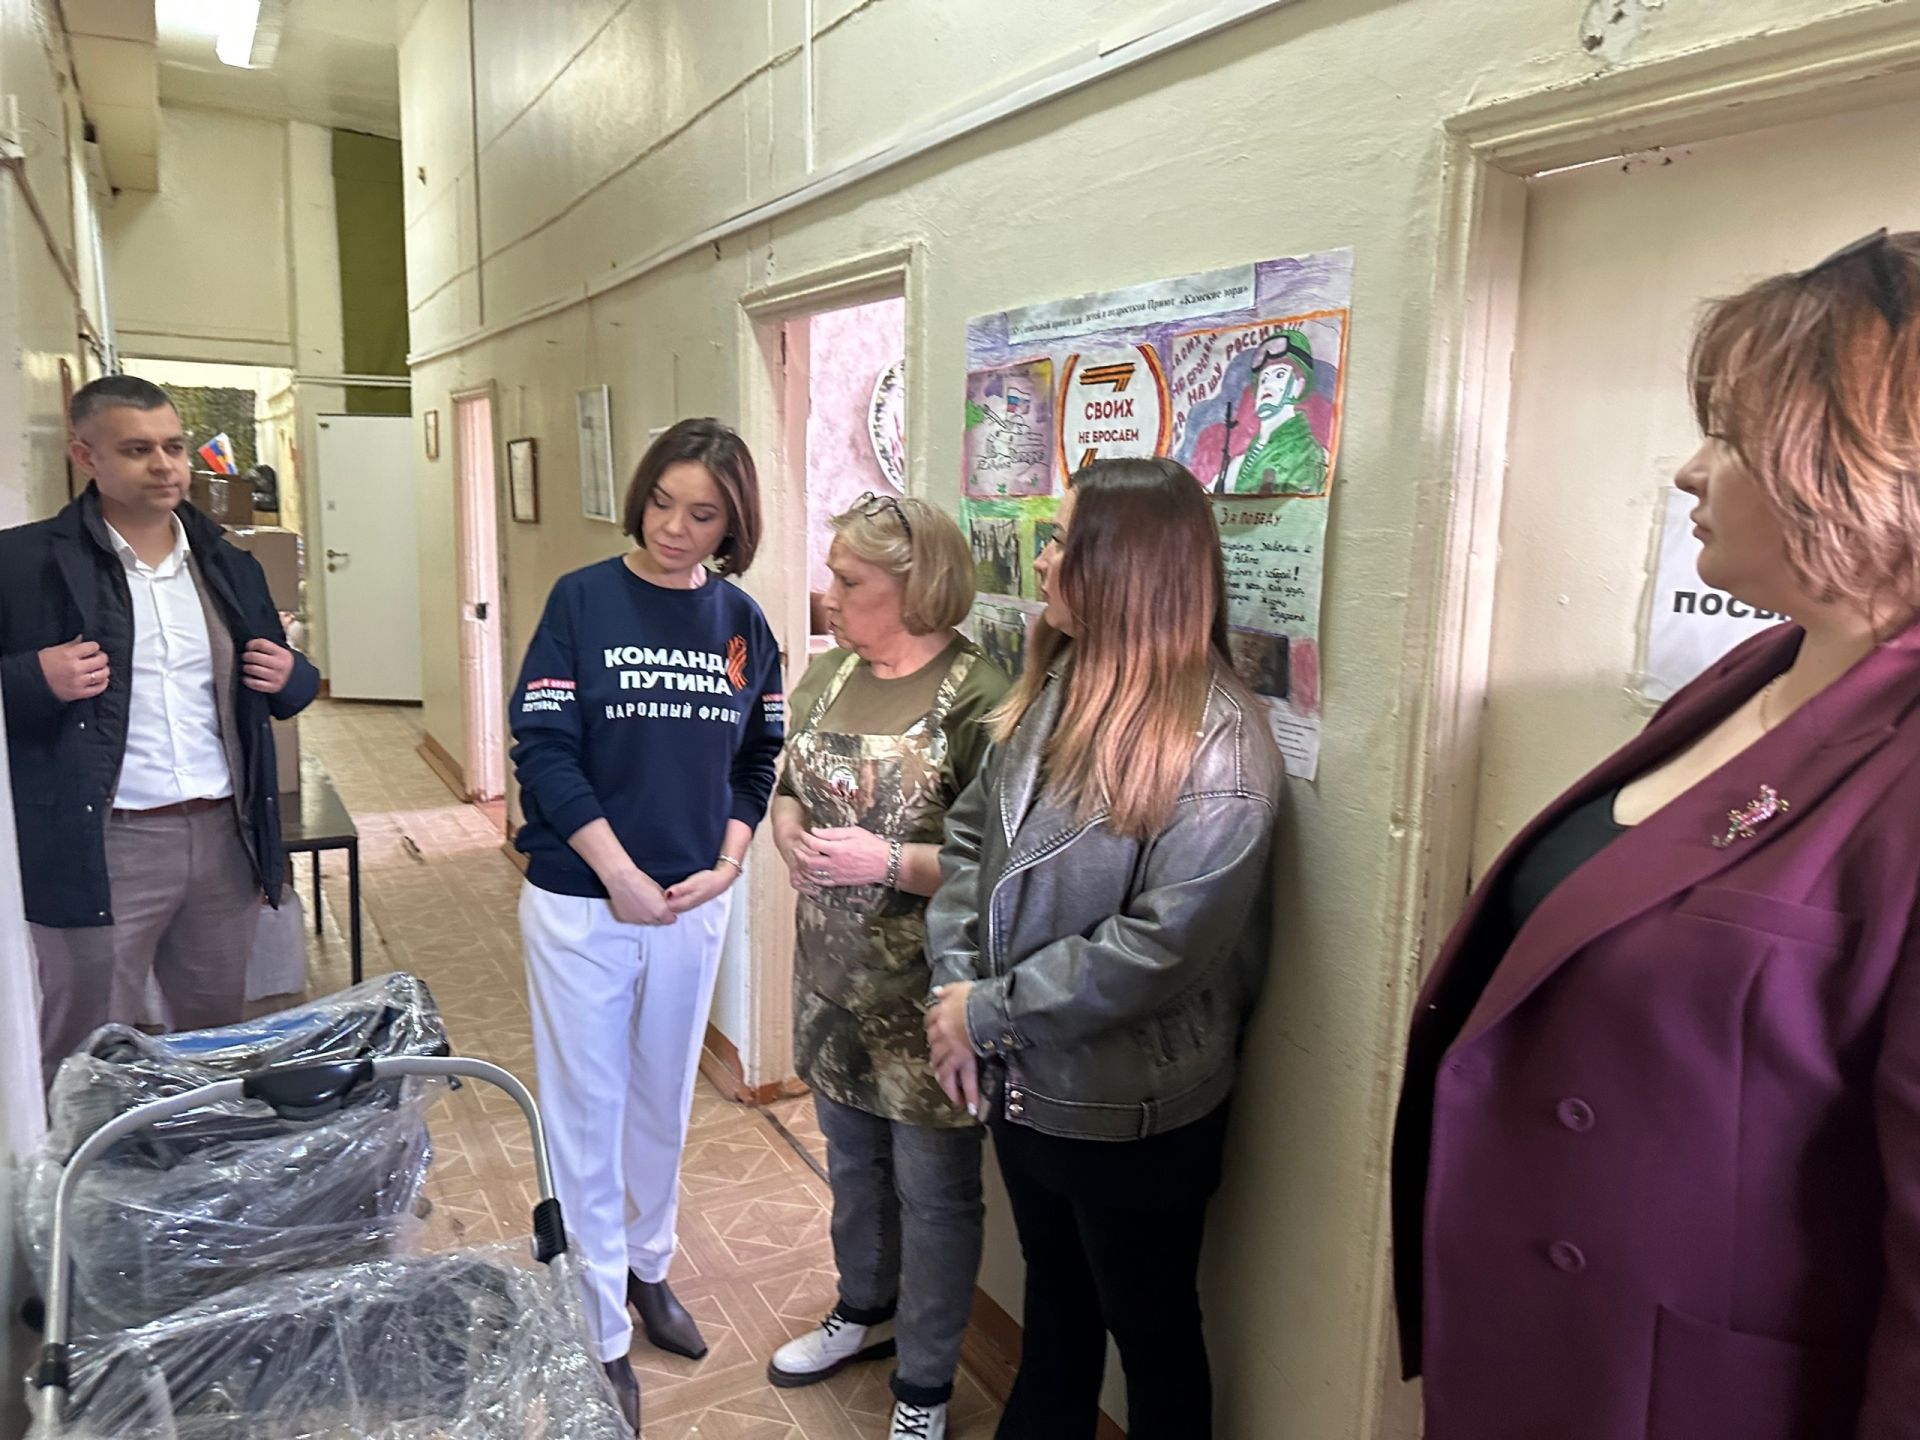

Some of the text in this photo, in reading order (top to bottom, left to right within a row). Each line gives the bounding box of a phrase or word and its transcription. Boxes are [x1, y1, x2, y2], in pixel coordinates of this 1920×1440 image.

[1085, 398, 1135, 421] СВОИХ
[1078, 429, 1140, 444] НЕ БРОСАЕМ
[603, 646, 733, 676] КОМАНД
[619, 669, 734, 697] ПУТИНА
[605, 702, 693, 720] НАРОДНЫЙ
[698, 704, 743, 726] ФРОНТ
